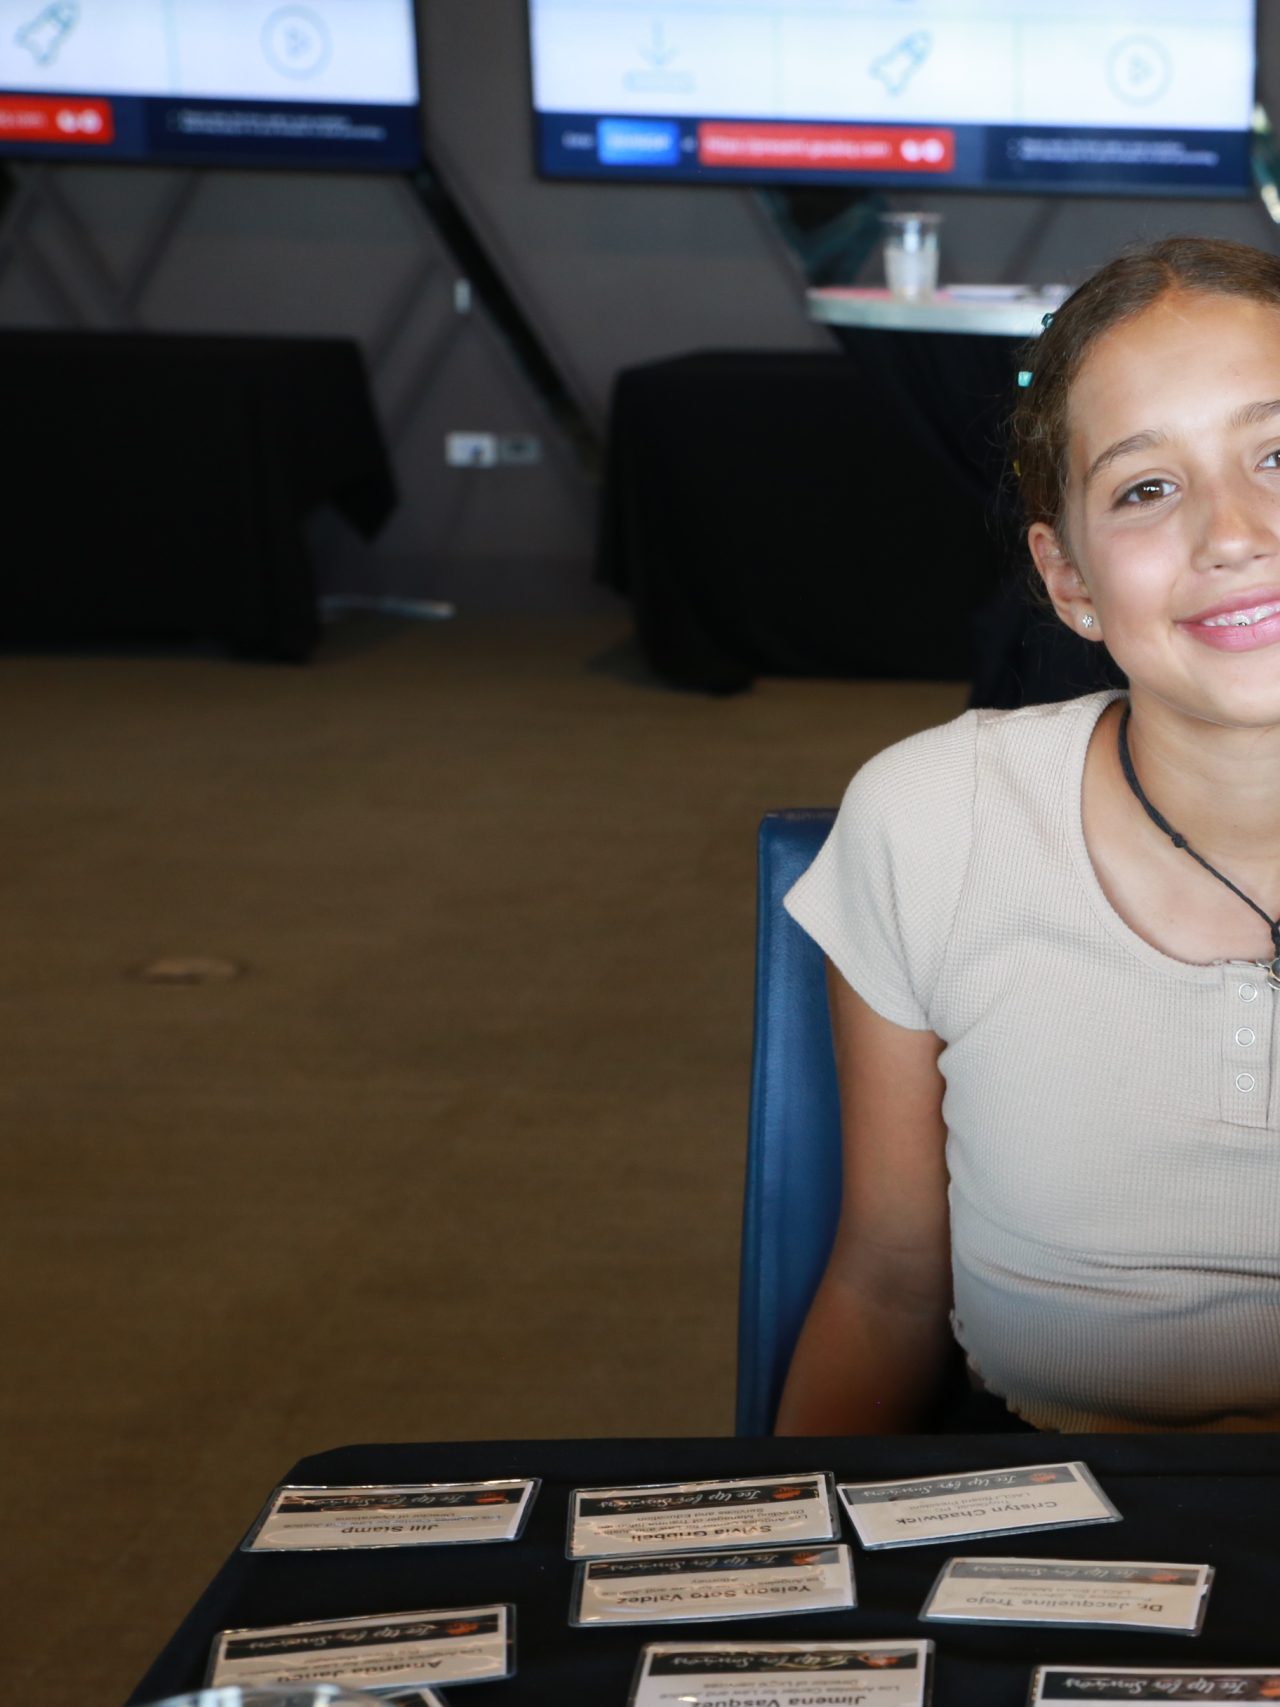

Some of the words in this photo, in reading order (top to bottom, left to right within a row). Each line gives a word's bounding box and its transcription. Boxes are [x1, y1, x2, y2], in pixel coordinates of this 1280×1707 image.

[940, 1480, 961, 1490] for
[968, 1477, 990, 1487] Up
[997, 1475, 1017, 1485] Tee
[412, 1494, 436, 1504] Up
[678, 1494, 703, 1505] for
[708, 1491, 732, 1502] Up
[736, 1490, 761, 1500] Tee
[991, 1501, 1057, 1512] Cristyn
[896, 1510, 987, 1525] Chadwick
[341, 1526, 404, 1534] Stamp
[714, 1525, 771, 1535] Sylvia
[693, 1559, 718, 1569] for
[723, 1556, 748, 1567] Up
[690, 1590, 737, 1599] Soto
[744, 1585, 811, 1595] Yeison
[617, 1594, 683, 1605] Valdez
[966, 1596, 1014, 1607] Trejo
[1022, 1600, 1130, 1610] Jacqueline
[1137, 1603, 1163, 1613] Dr.
[373, 1627, 401, 1638] Up
[352, 1660, 442, 1675] Amanda
[1064, 1678, 1148, 1695] Survivors
[1152, 1680, 1183, 1694] for
[1187, 1677, 1215, 1694] Up
[1219, 1680, 1248, 1695] Tee
[789, 1696, 866, 1706] Jimena
